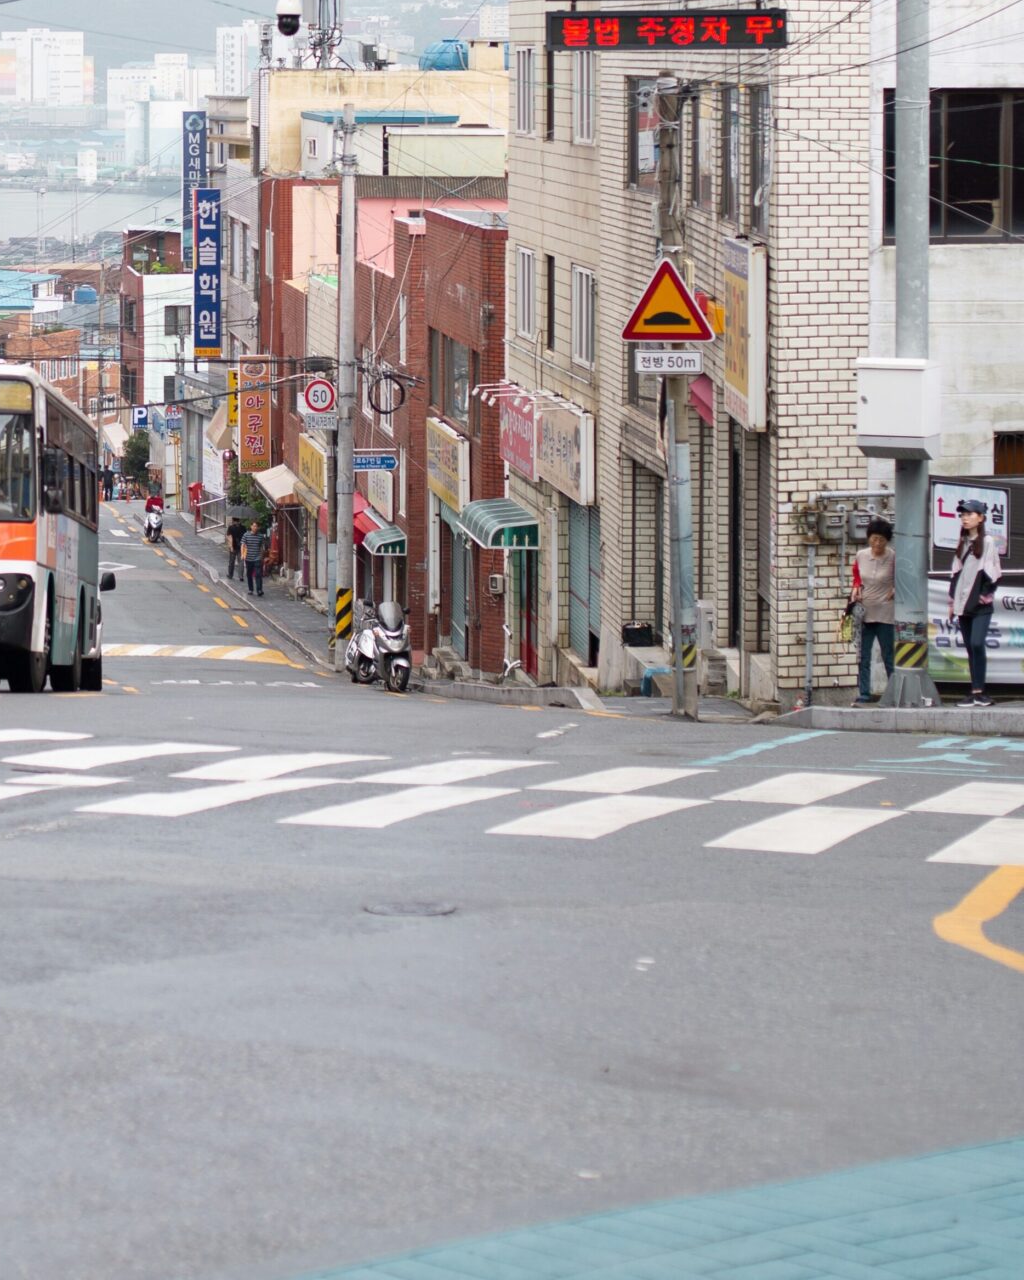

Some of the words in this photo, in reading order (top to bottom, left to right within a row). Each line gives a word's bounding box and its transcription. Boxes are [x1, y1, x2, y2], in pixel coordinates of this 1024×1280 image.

[562, 17, 621, 46] 불법
[637, 16, 731, 46] 주정차
[745, 15, 783, 45] 무
[197, 199, 219, 340] 한솔학원
[640, 356, 664, 369] 전방
[667, 356, 696, 369] 50m
[312, 390, 328, 403] 50
[133, 407, 148, 424] P
[245, 395, 265, 455] 아구찜
